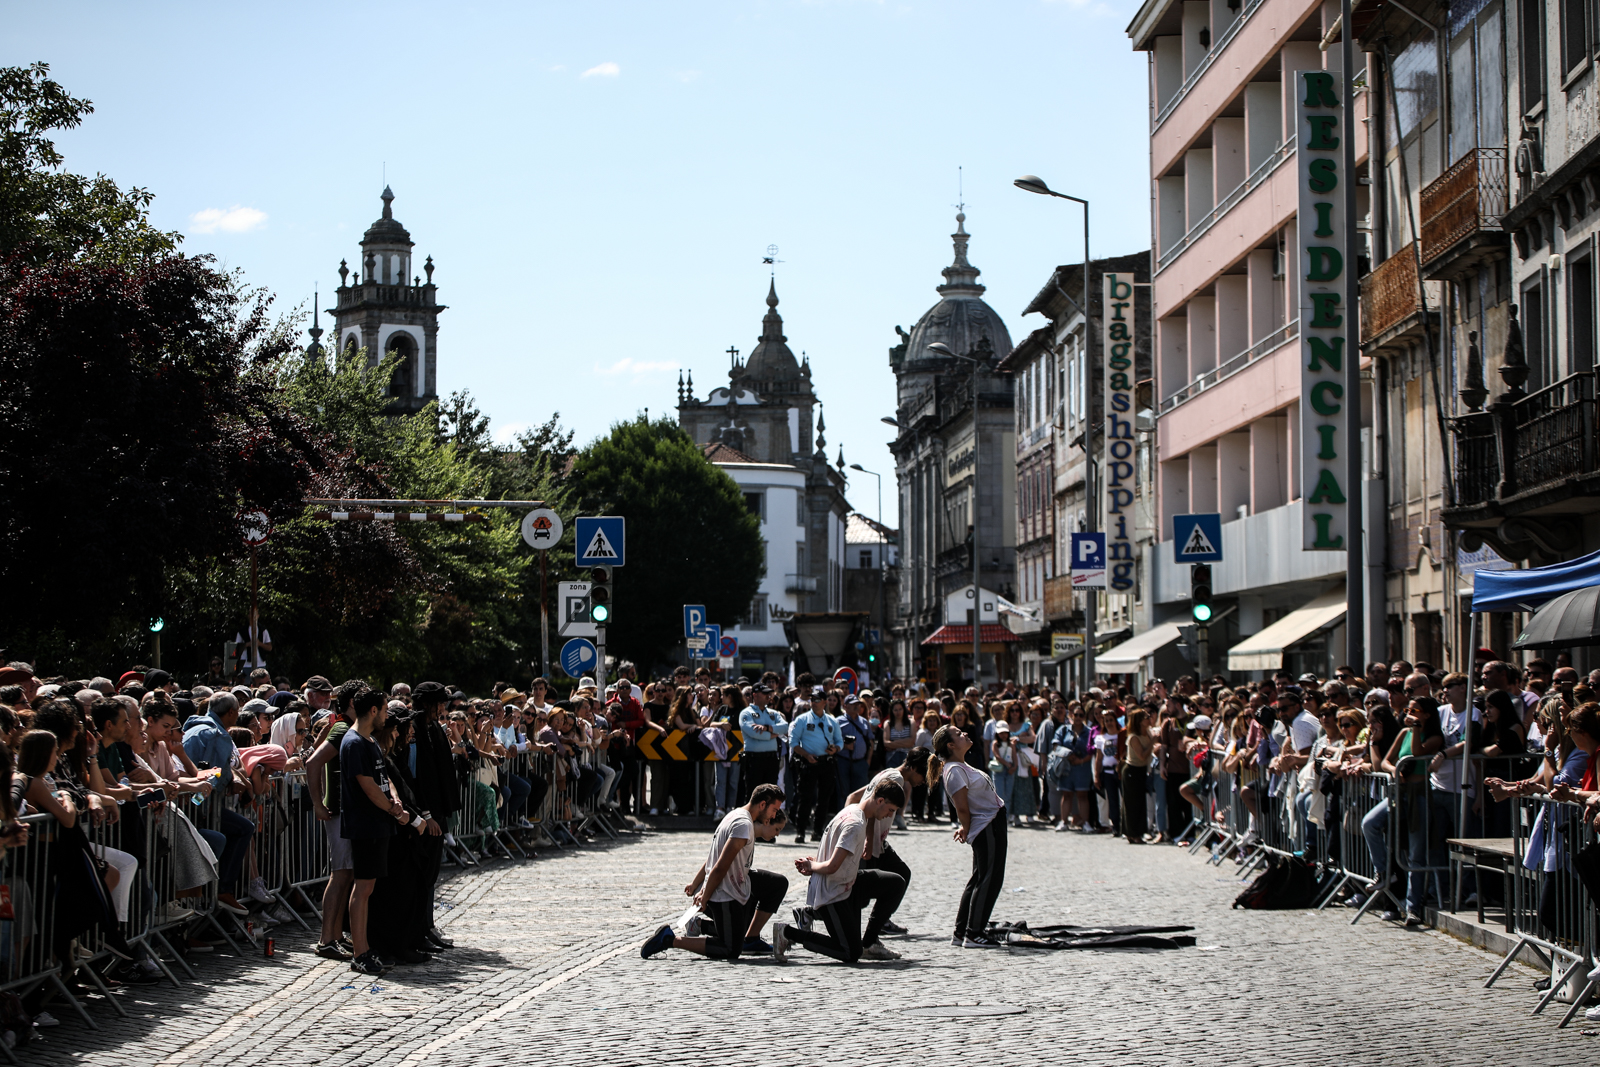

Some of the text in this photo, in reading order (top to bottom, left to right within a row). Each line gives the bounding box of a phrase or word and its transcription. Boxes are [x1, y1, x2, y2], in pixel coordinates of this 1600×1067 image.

[1303, 72, 1346, 548] RESIDENCIAL
[1108, 272, 1134, 591] bragashopping
[1079, 540, 1098, 562] P
[570, 598, 586, 621] P
[689, 609, 702, 634] P
